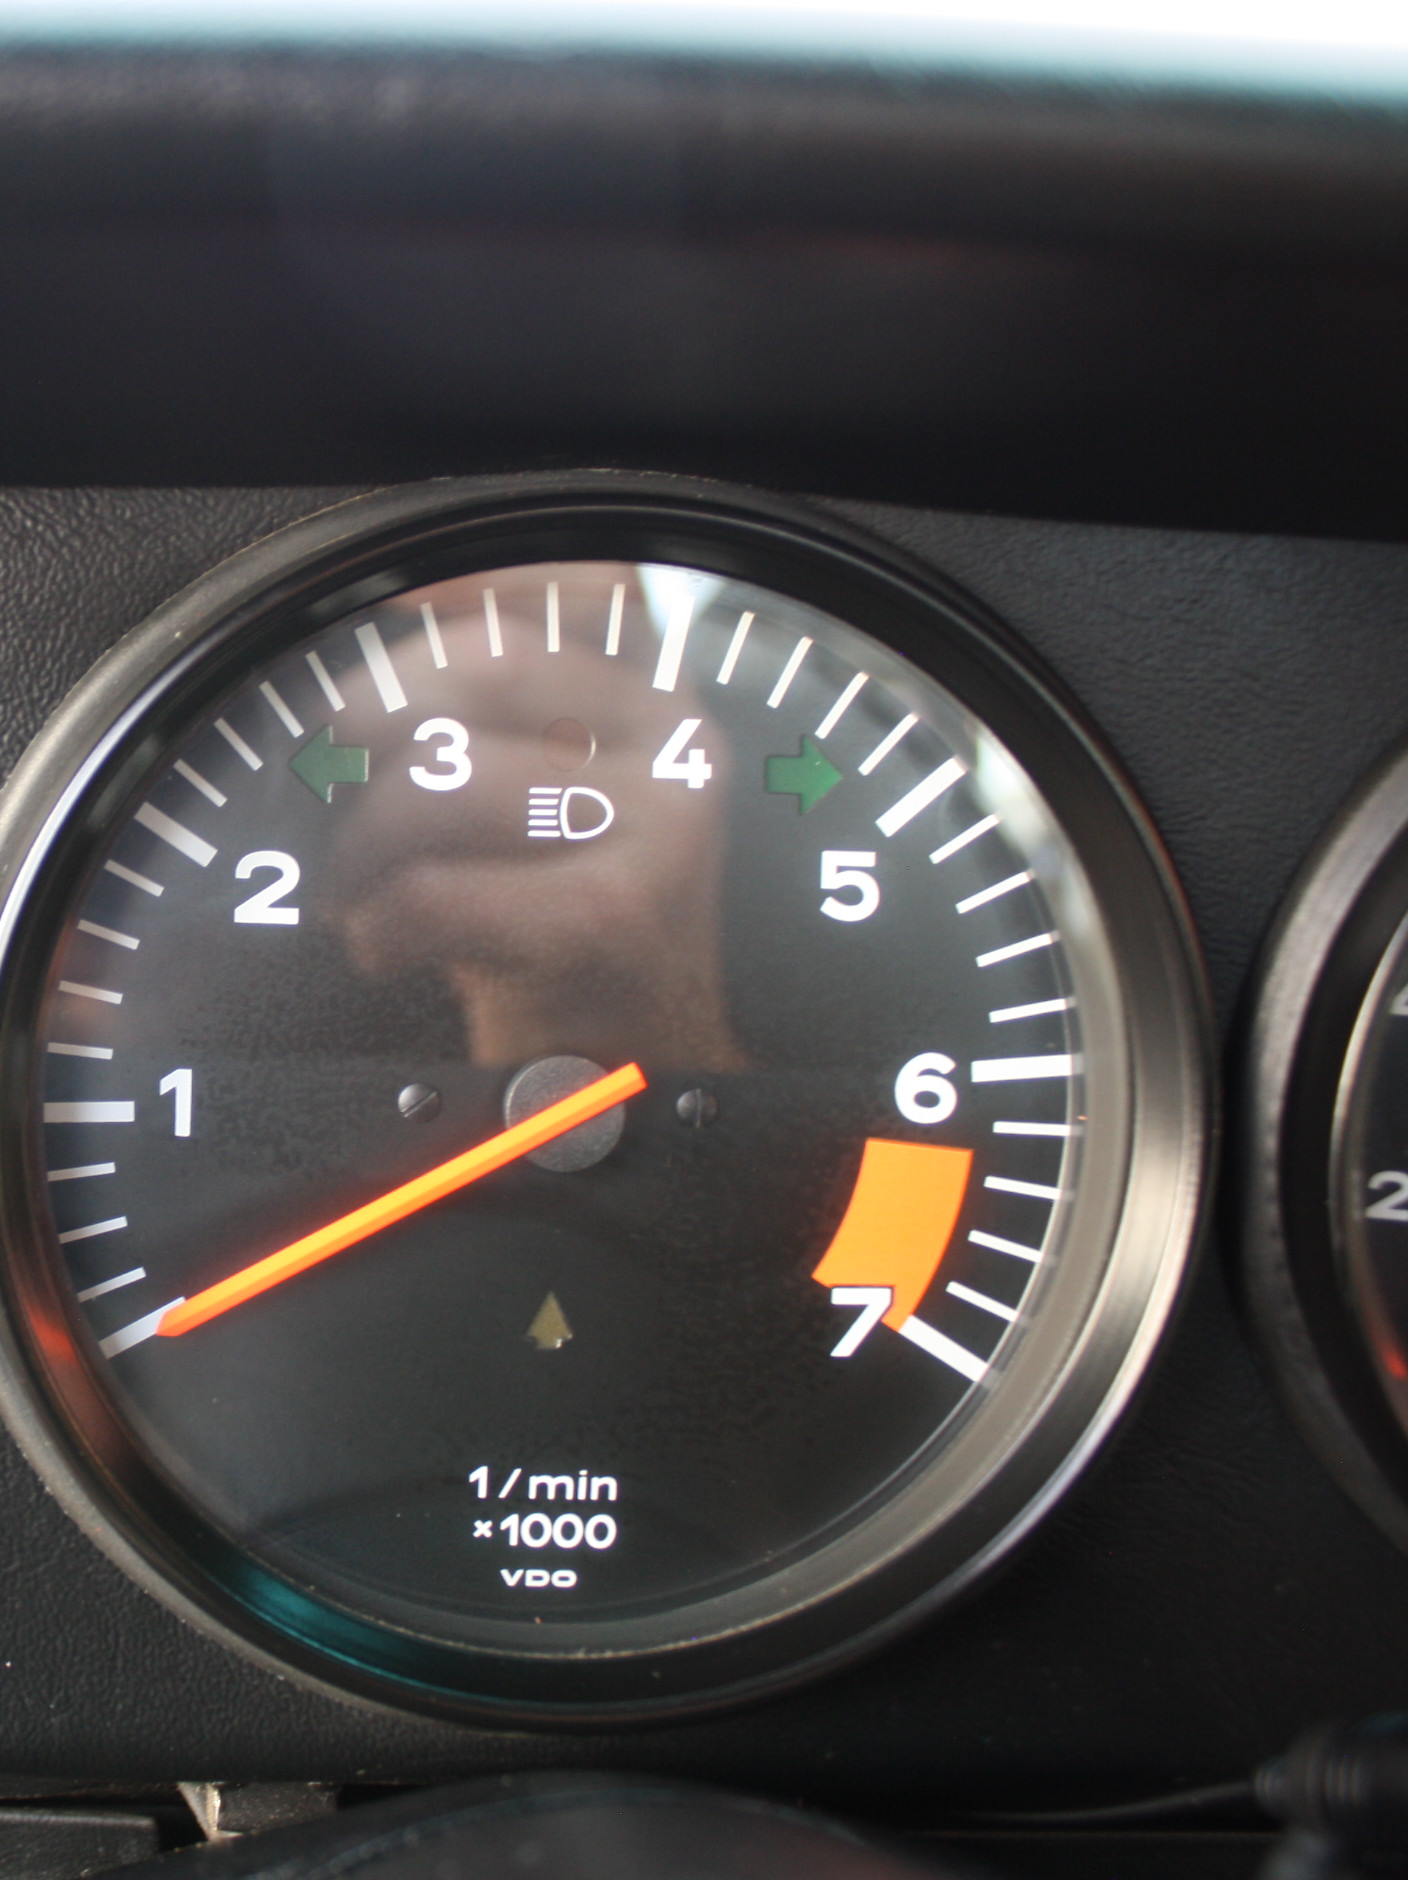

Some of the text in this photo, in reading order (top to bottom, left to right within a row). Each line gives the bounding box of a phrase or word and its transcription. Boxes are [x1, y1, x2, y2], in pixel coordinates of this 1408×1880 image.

[408, 717, 473, 792] 3
[651, 718, 713, 789] 4
[233, 850, 301, 925] 2
[820, 849, 880, 922] 5
[159, 1068, 193, 1138] 1
[894, 1051, 958, 1125] 6
[830, 1286, 892, 1358] 7
[500, 1569, 578, 1588] VDO
